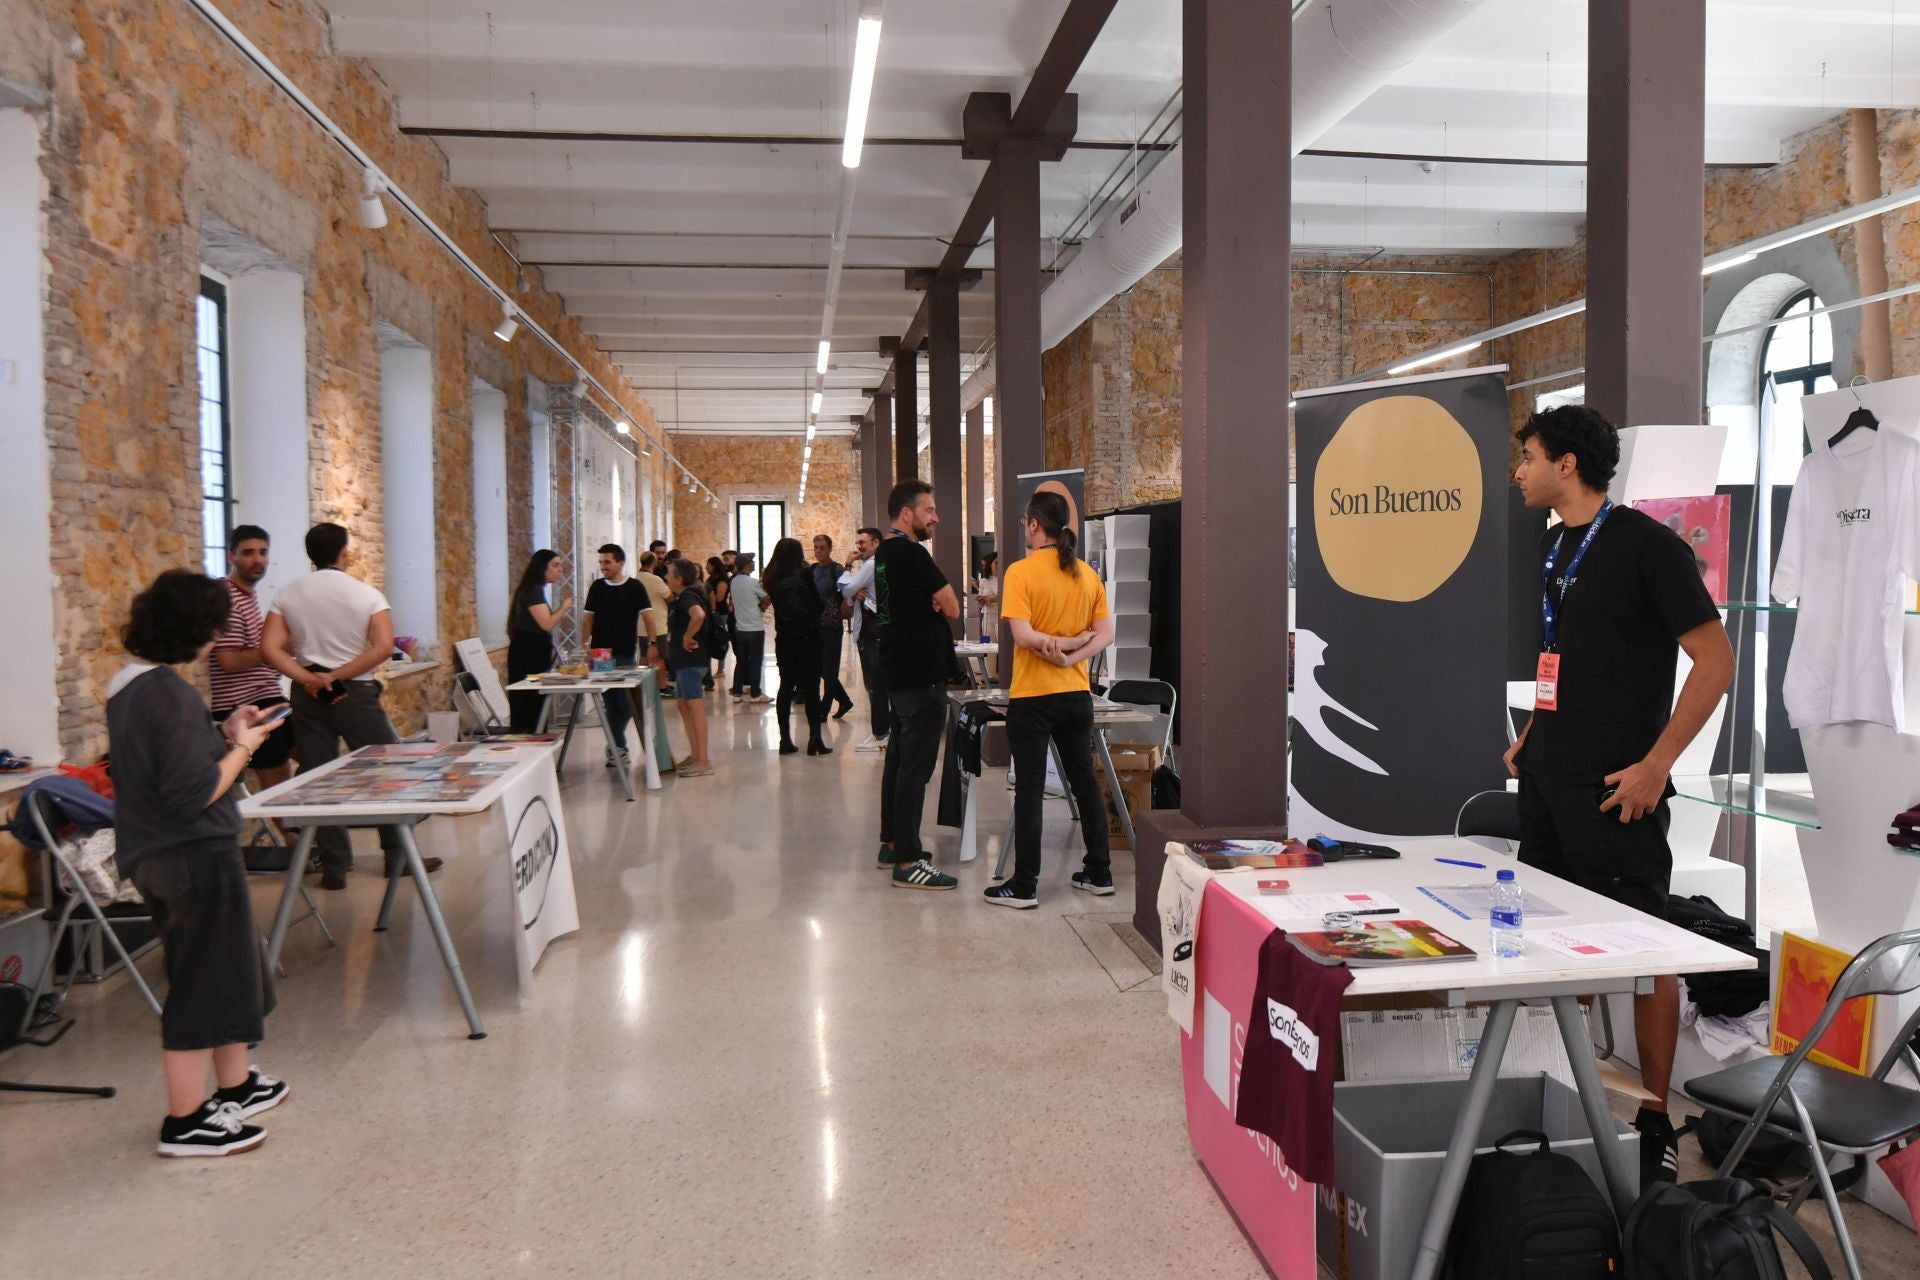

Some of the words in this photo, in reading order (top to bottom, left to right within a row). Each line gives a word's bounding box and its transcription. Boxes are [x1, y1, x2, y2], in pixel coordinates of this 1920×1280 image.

[1330, 487, 1369, 516] Son
[1374, 485, 1462, 514] Buenos
[1320, 1188, 1368, 1238] NAEX
